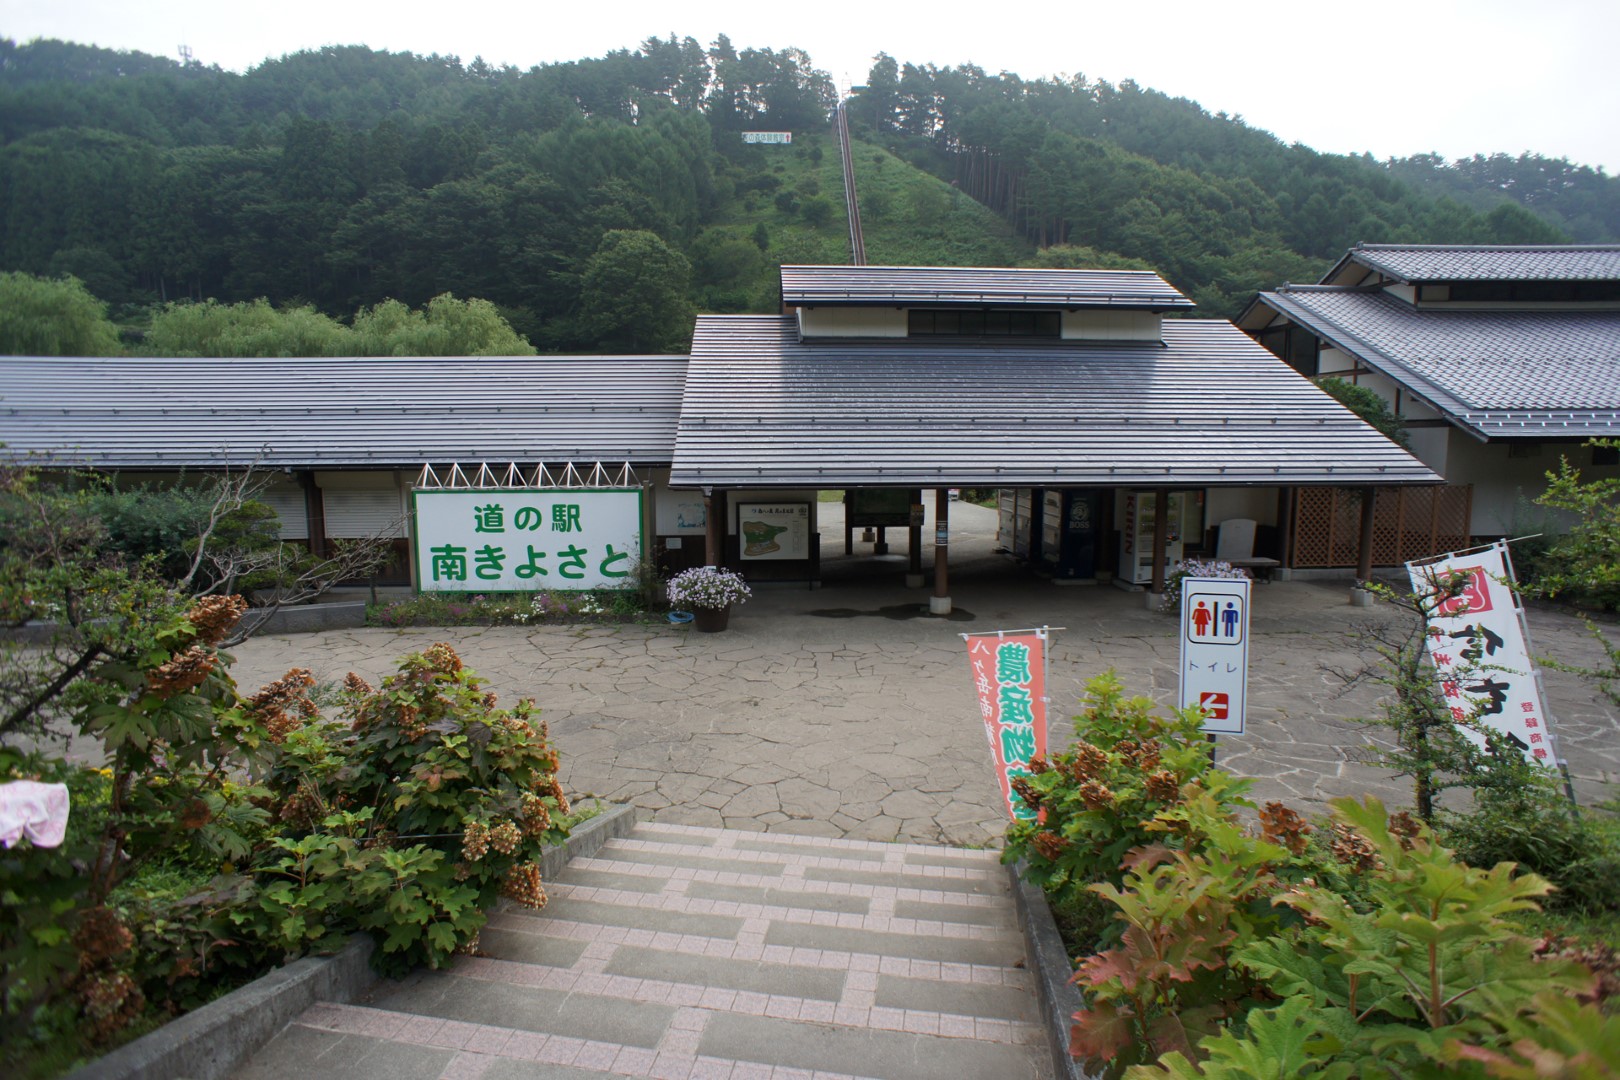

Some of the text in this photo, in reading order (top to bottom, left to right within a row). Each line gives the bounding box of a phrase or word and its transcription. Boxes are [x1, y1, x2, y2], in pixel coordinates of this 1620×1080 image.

[474, 503, 582, 533] 道の駅
[1069, 521, 1090, 529] BOSS
[1125, 496, 1135, 554] KIRIN
[430, 543, 629, 581] 南きよさと
[1189, 660, 1238, 673] トイレ
